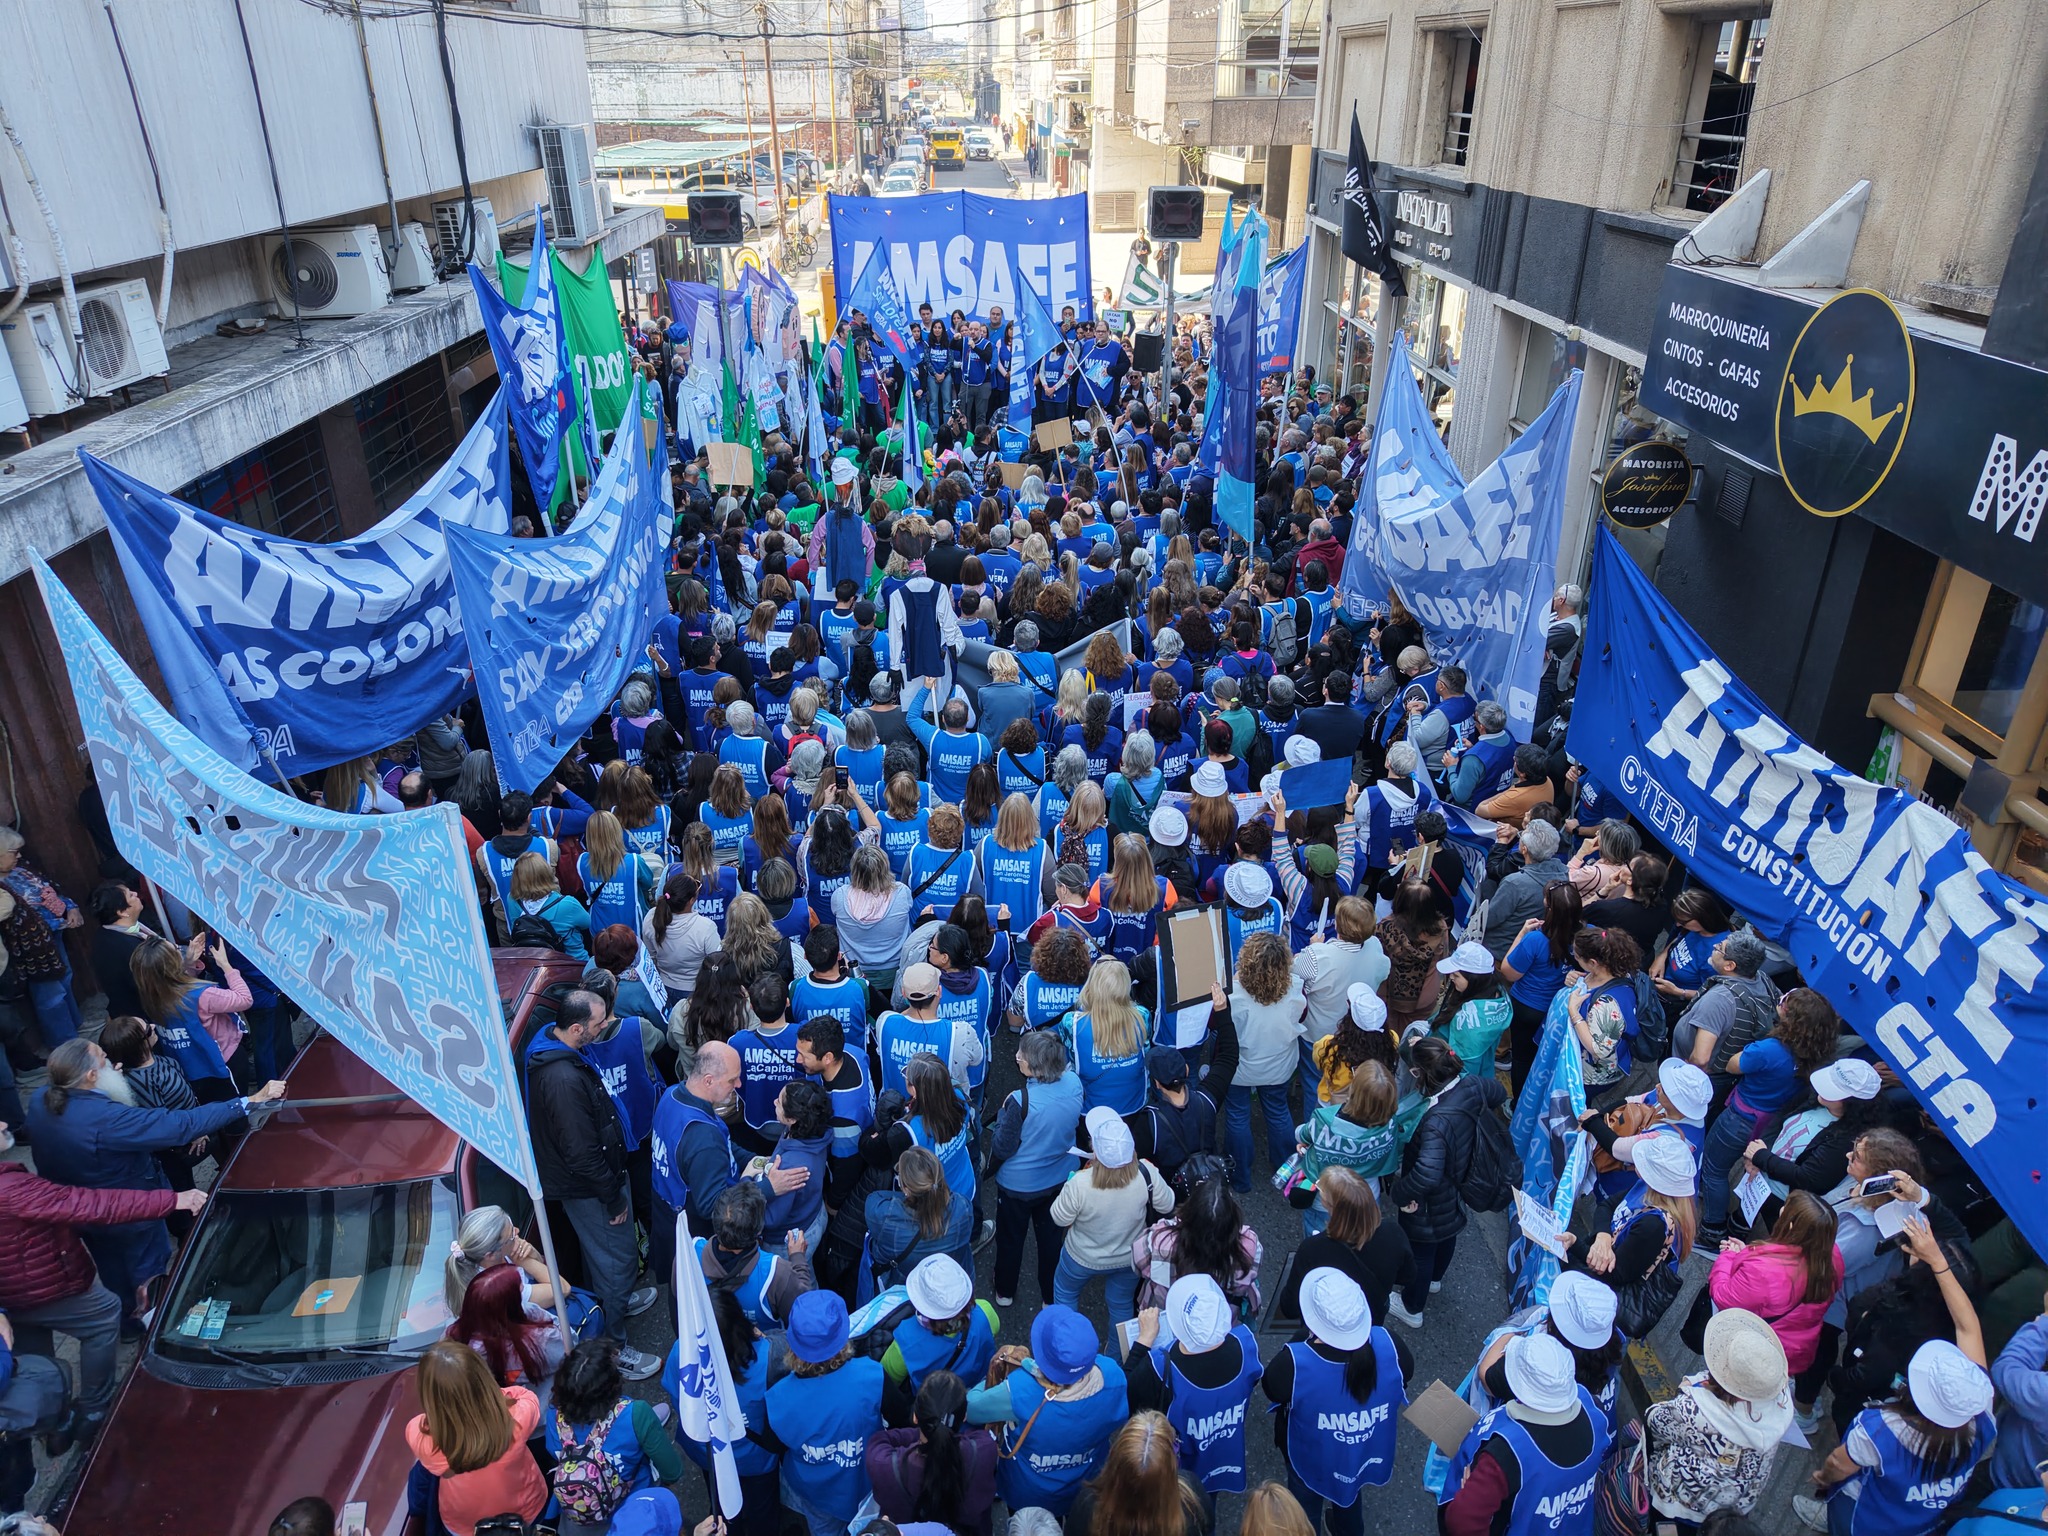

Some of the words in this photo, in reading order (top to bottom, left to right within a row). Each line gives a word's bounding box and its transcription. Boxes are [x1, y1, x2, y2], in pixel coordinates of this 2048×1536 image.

[1395, 191, 1453, 236] NATALIA
[641, 252, 651, 272] E
[1669, 301, 1771, 351] MARROQUINERÍA
[1663, 337, 1703, 368] CINTOS
[1719, 358, 1761, 390] GAFAS
[1664, 379, 1739, 422] ACCESORIOS
[1622, 458, 1685, 470] MAYORISTA
[1612, 505, 1675, 516] ACCESORIOS
[1143, 528, 1161, 539] AMSA
[775, 610, 794, 621] SAFE
[743, 642, 766, 653] AMSA
[499, 645, 552, 713] SAN
[690, 690, 714, 701] AMSA
[1110, 687, 1124, 701] SAFE
[766, 704, 790, 716] AMSA
[939, 753, 972, 766] AMSAFE
[1164, 753, 1189, 769] AMSAFE
[1620, 755, 1699, 857] CTERA
[713, 824, 750, 840] AMSAFE
[885, 830, 920, 846] AMSAFE
[992, 859, 1030, 873] AMSAFE
[819, 877, 850, 893] AMSA
[691, 899, 724, 915] SAFE
[1721, 824, 1893, 984] CONSTITUCIÓN
[1676, 938, 1693, 967] AMSAFE
[1037, 987, 1079, 1004] AMSAFE
[936, 999, 978, 1020] AMSAFE
[744, 1048, 797, 1064] AMSAFE
[890, 1038, 938, 1058] AMSAFE
[1091, 1056, 1105, 1064] San
[1875, 1001, 1997, 1149] CTA
[1754, 1176, 1768, 1195] SAFE
[1318, 1403, 1391, 1434] AMSAFE
[1199, 1426, 1237, 1452] Garay
[1333, 1426, 1375, 1445] Garay
[801, 1436, 863, 1464] AMSAFE
[1905, 1466, 1976, 1502] AMSAF
